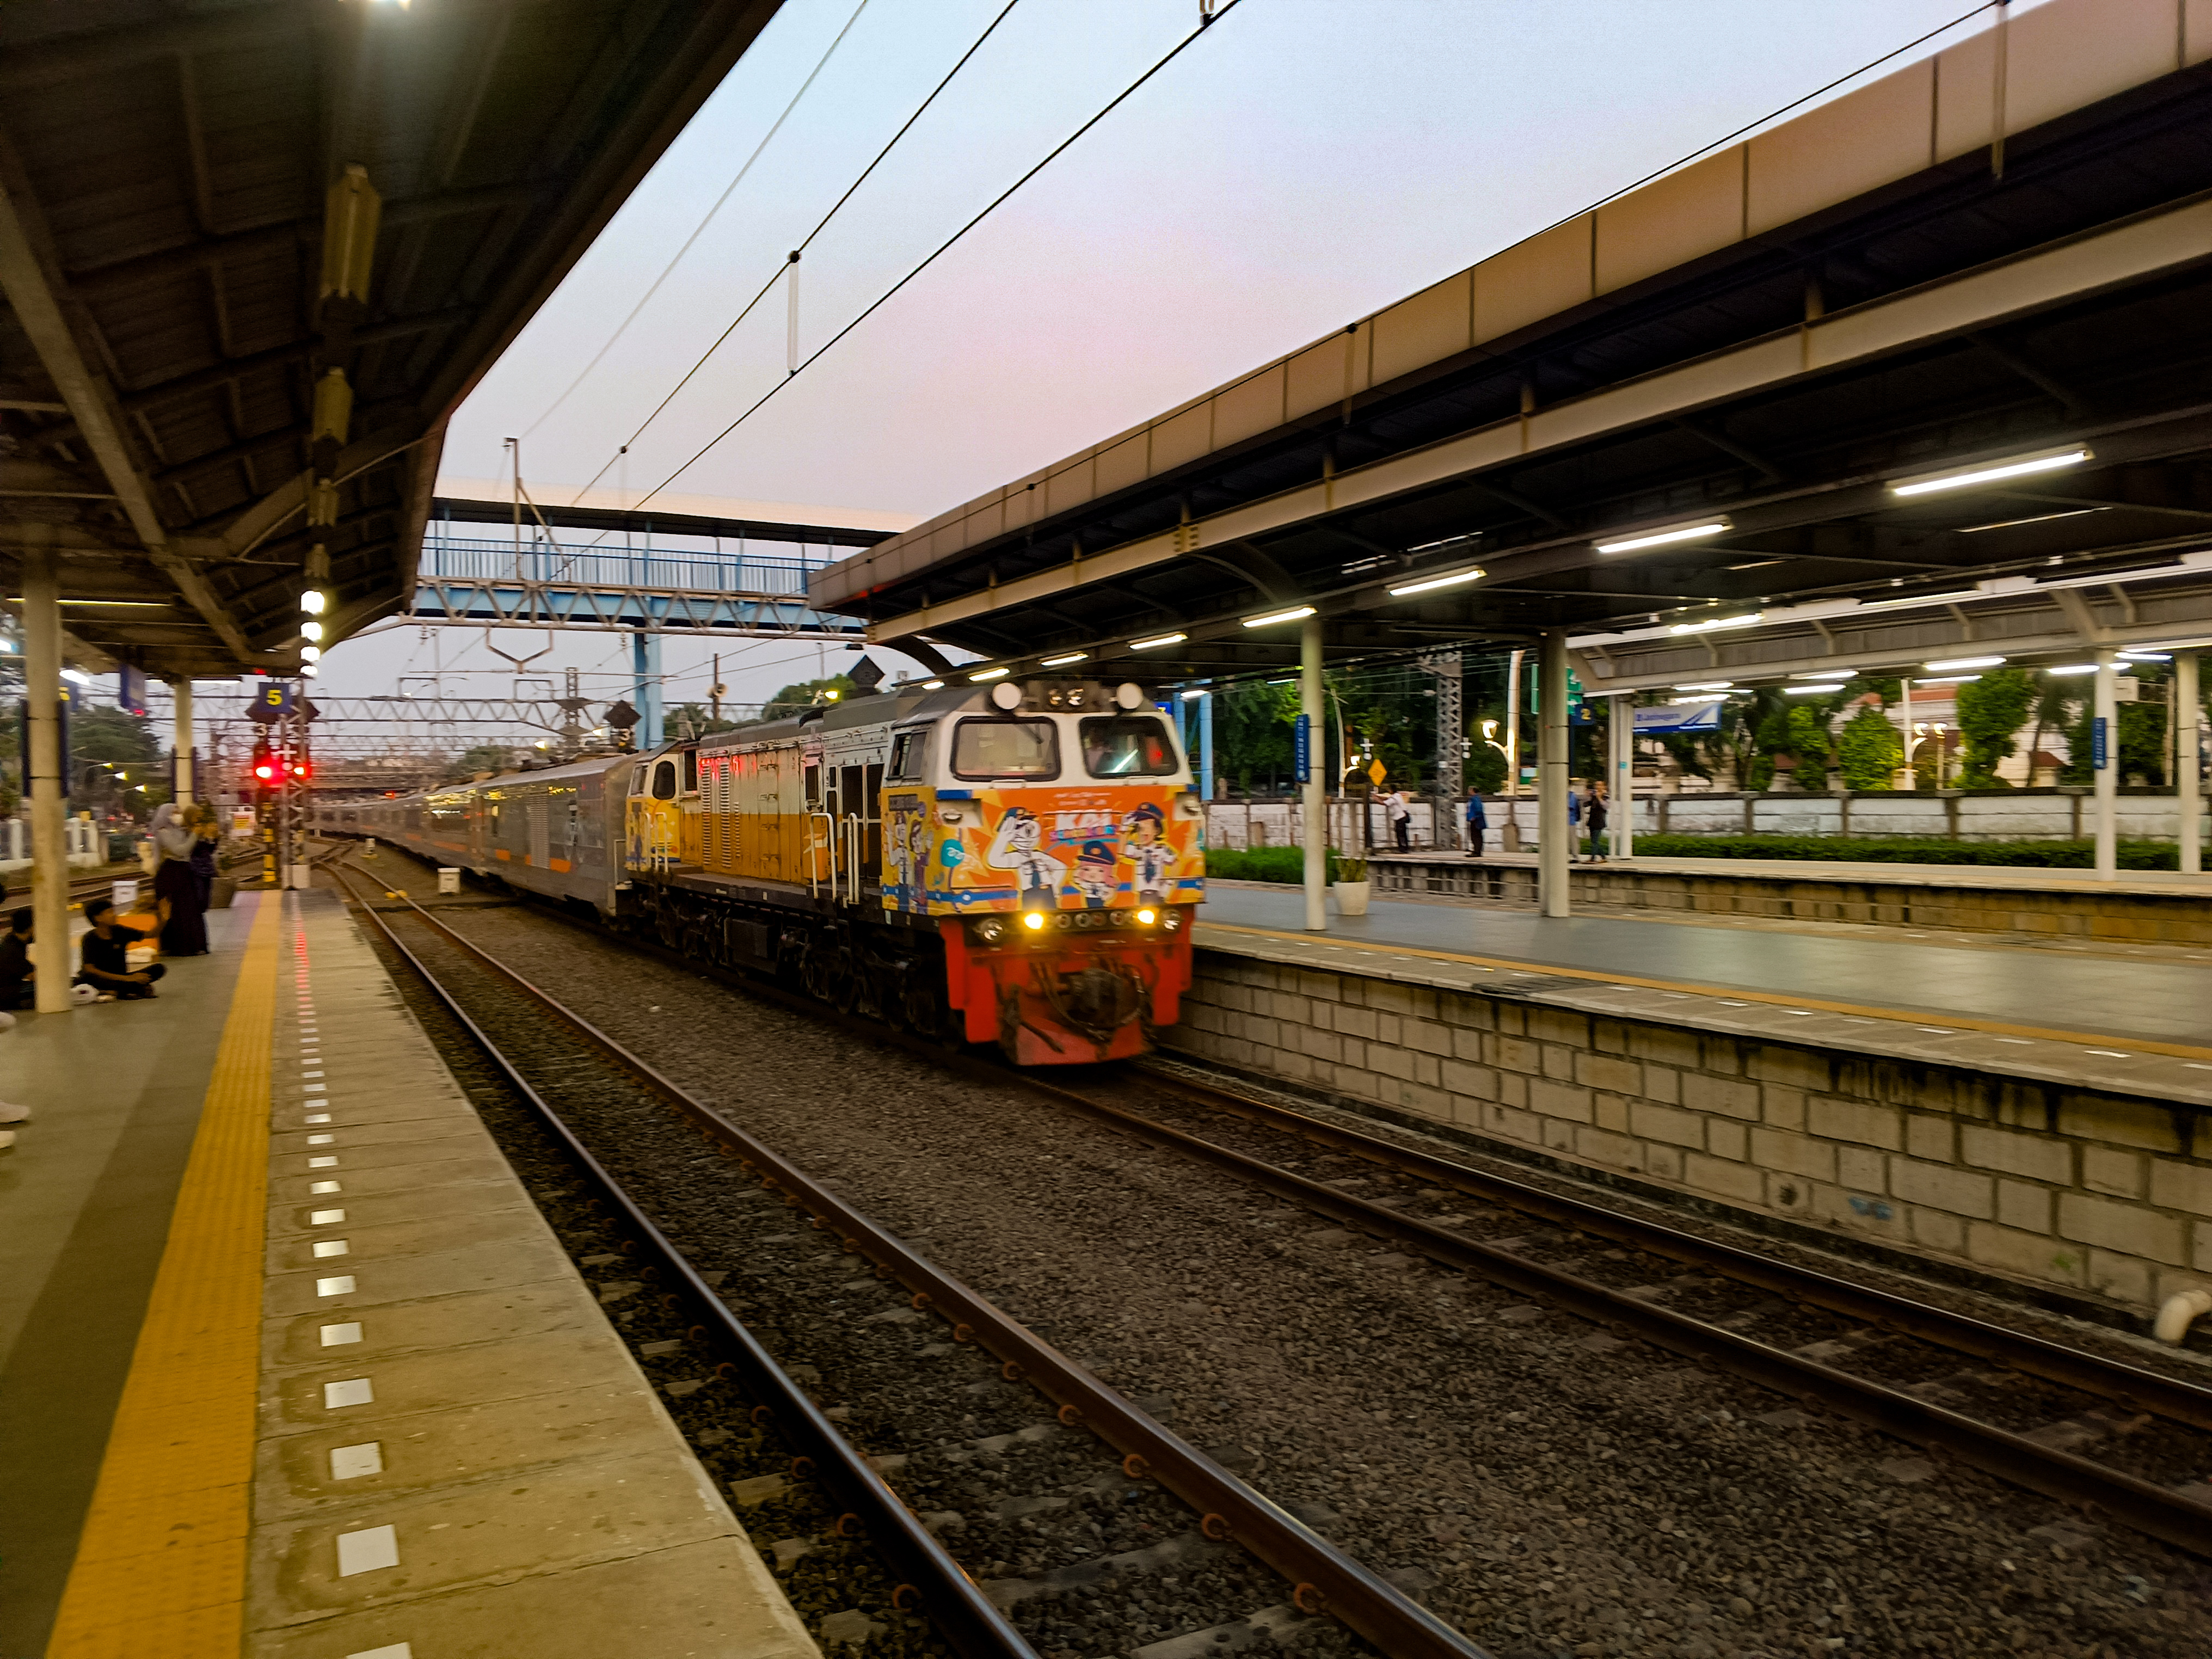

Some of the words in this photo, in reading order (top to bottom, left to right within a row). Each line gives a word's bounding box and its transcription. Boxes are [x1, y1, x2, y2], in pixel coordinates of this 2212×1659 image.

[267, 689, 282, 705] 5
[1581, 708, 1591, 720] 2
[253, 723, 268, 736] 3
[619, 728, 630, 741] 3
